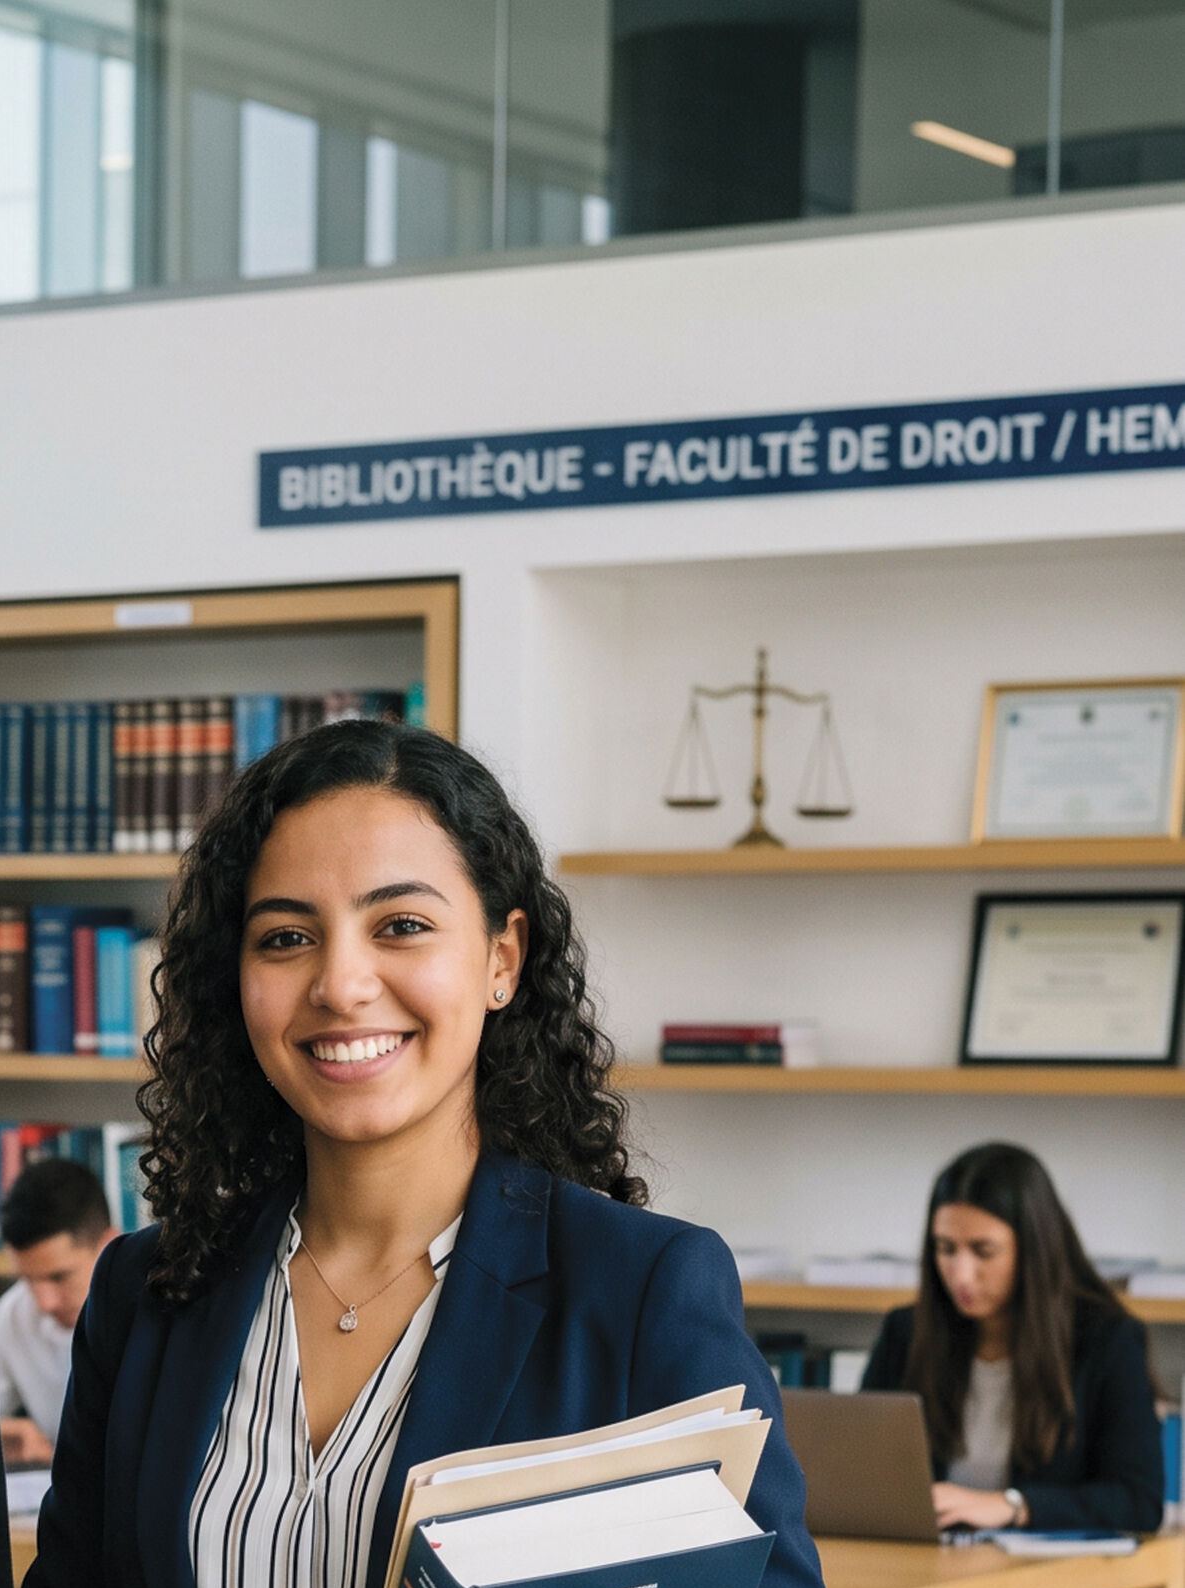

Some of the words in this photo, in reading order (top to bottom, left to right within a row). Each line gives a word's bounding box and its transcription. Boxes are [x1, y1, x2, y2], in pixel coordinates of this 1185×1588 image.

[279, 442, 584, 511] BIBLIOTHÈQUE
[623, 417, 819, 487] FACULTÉ
[828, 424, 891, 474] DE
[900, 412, 1046, 469] DROIT
